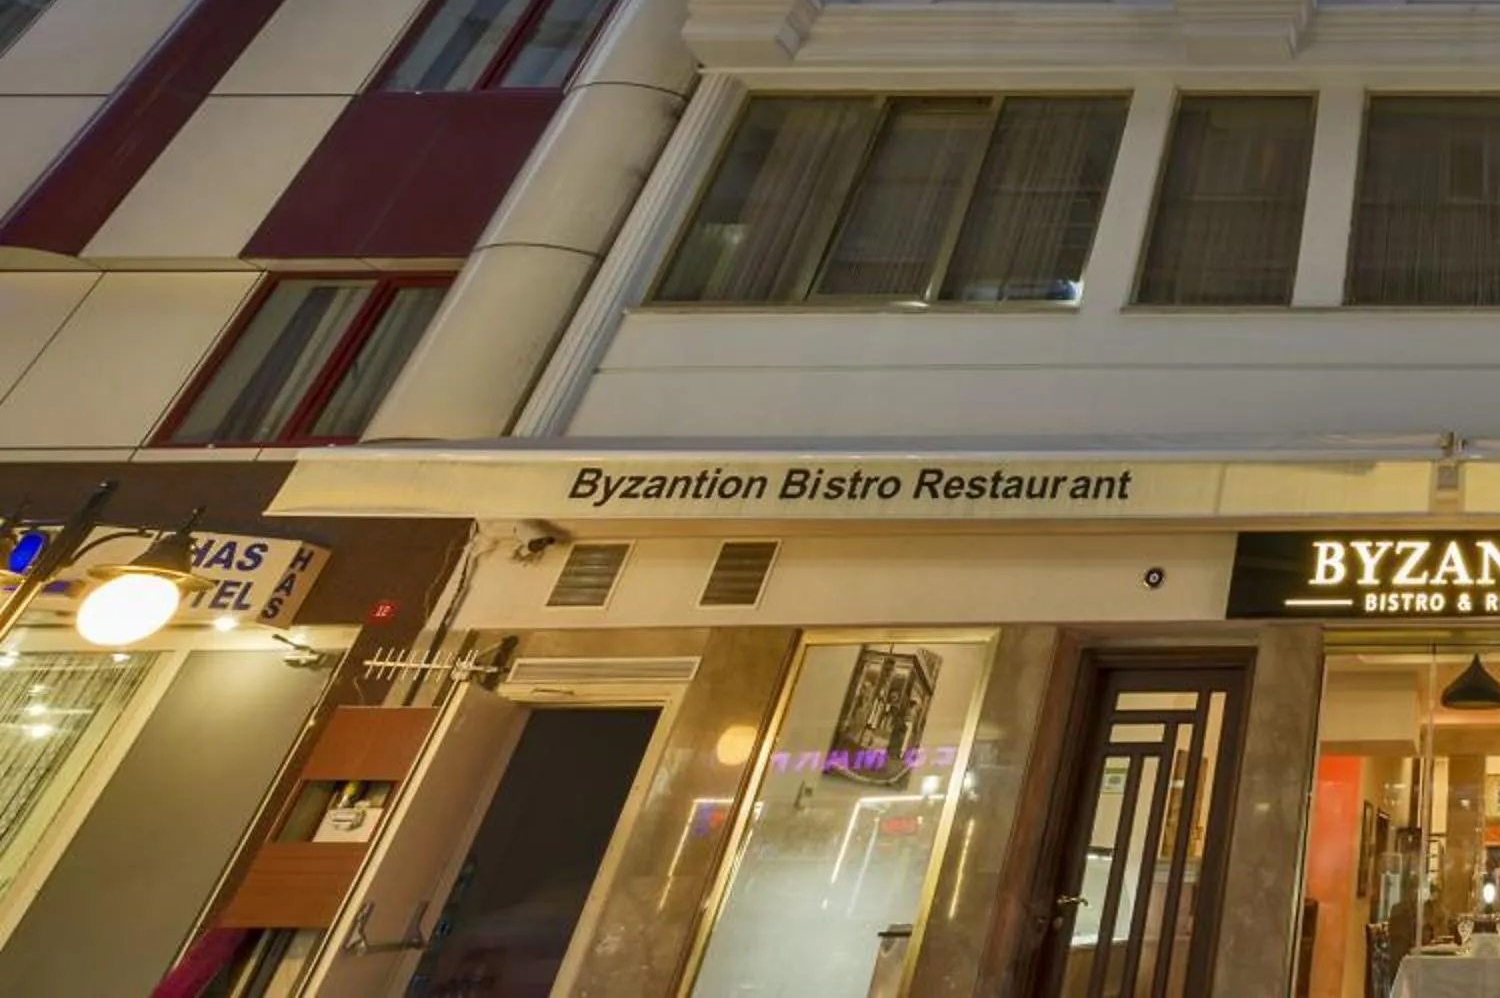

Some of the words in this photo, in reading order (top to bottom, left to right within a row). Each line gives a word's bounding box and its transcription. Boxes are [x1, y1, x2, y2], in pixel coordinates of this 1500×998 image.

[568, 466, 768, 506] Byzantion
[778, 468, 901, 500] Bistro
[912, 468, 1132, 500] Restaurant
[260, 546, 315, 620] HAS
[1364, 593, 1446, 613] BISTRO
[1457, 593, 1473, 613] &
